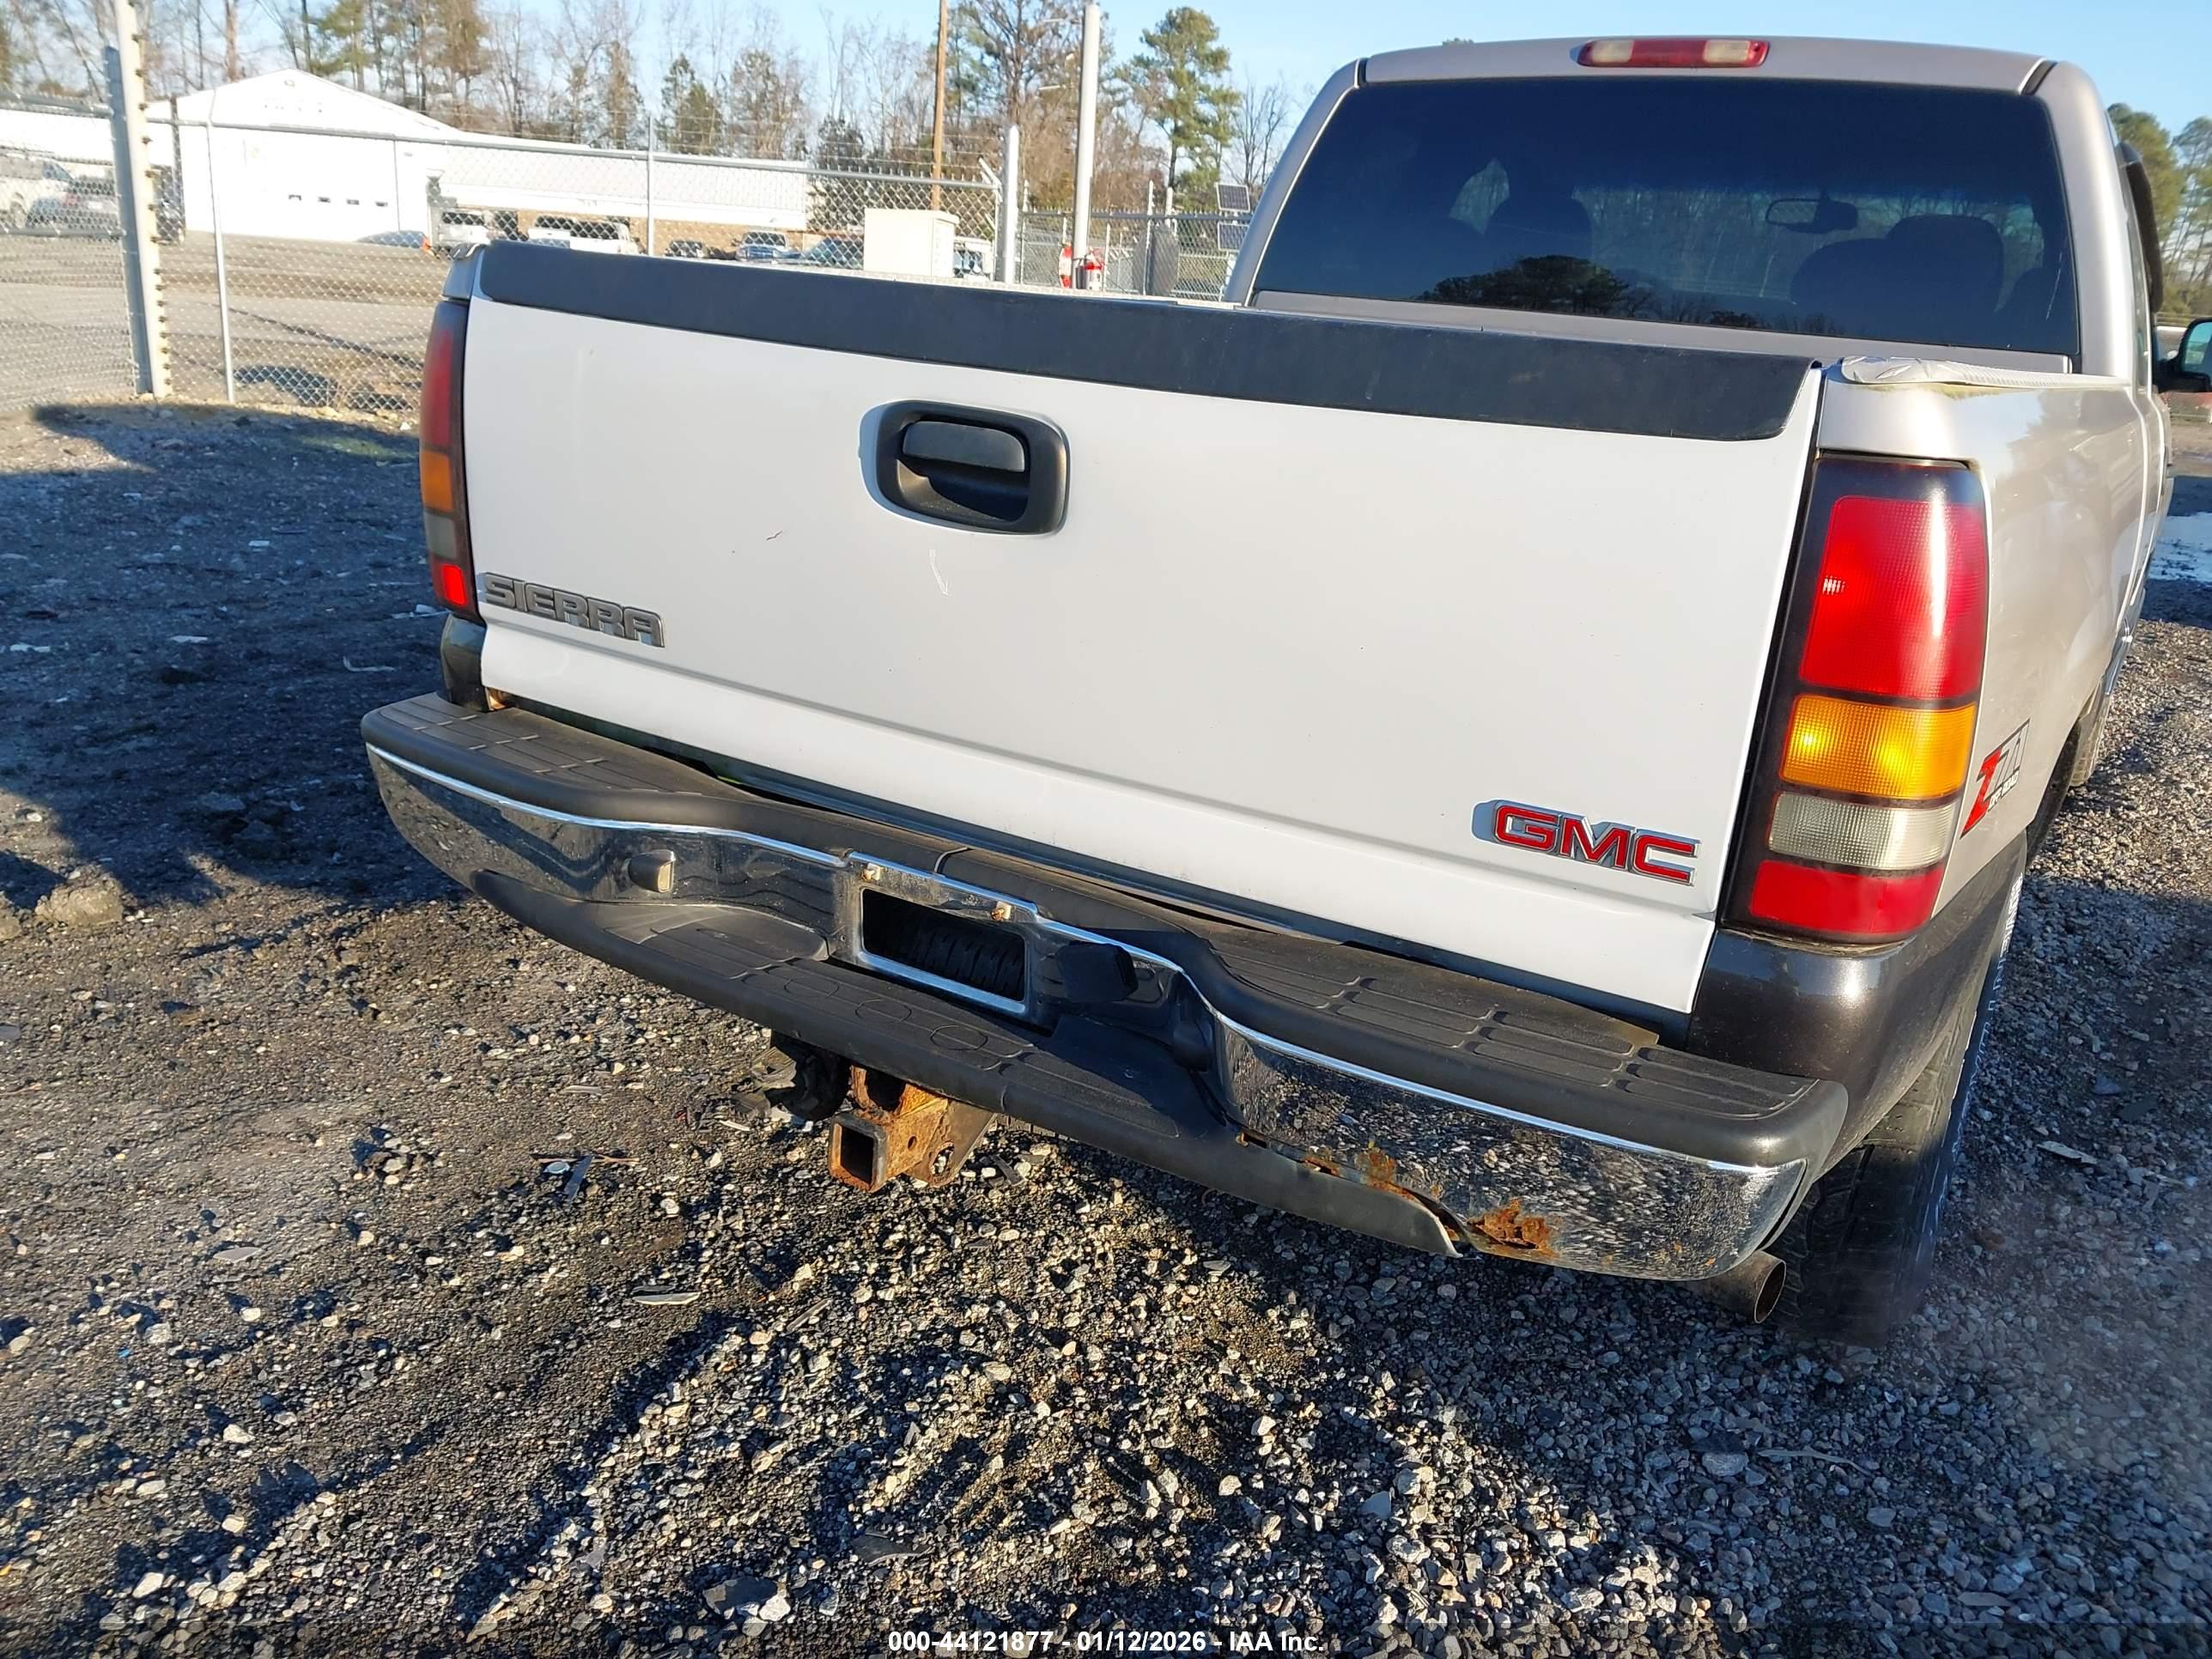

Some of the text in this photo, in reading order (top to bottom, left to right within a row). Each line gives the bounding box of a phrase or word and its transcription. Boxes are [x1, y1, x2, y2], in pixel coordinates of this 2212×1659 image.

[483, 573, 665, 647] SIERRA
[1960, 718, 2030, 840] Z71
[1494, 802, 1701, 887] GMC
